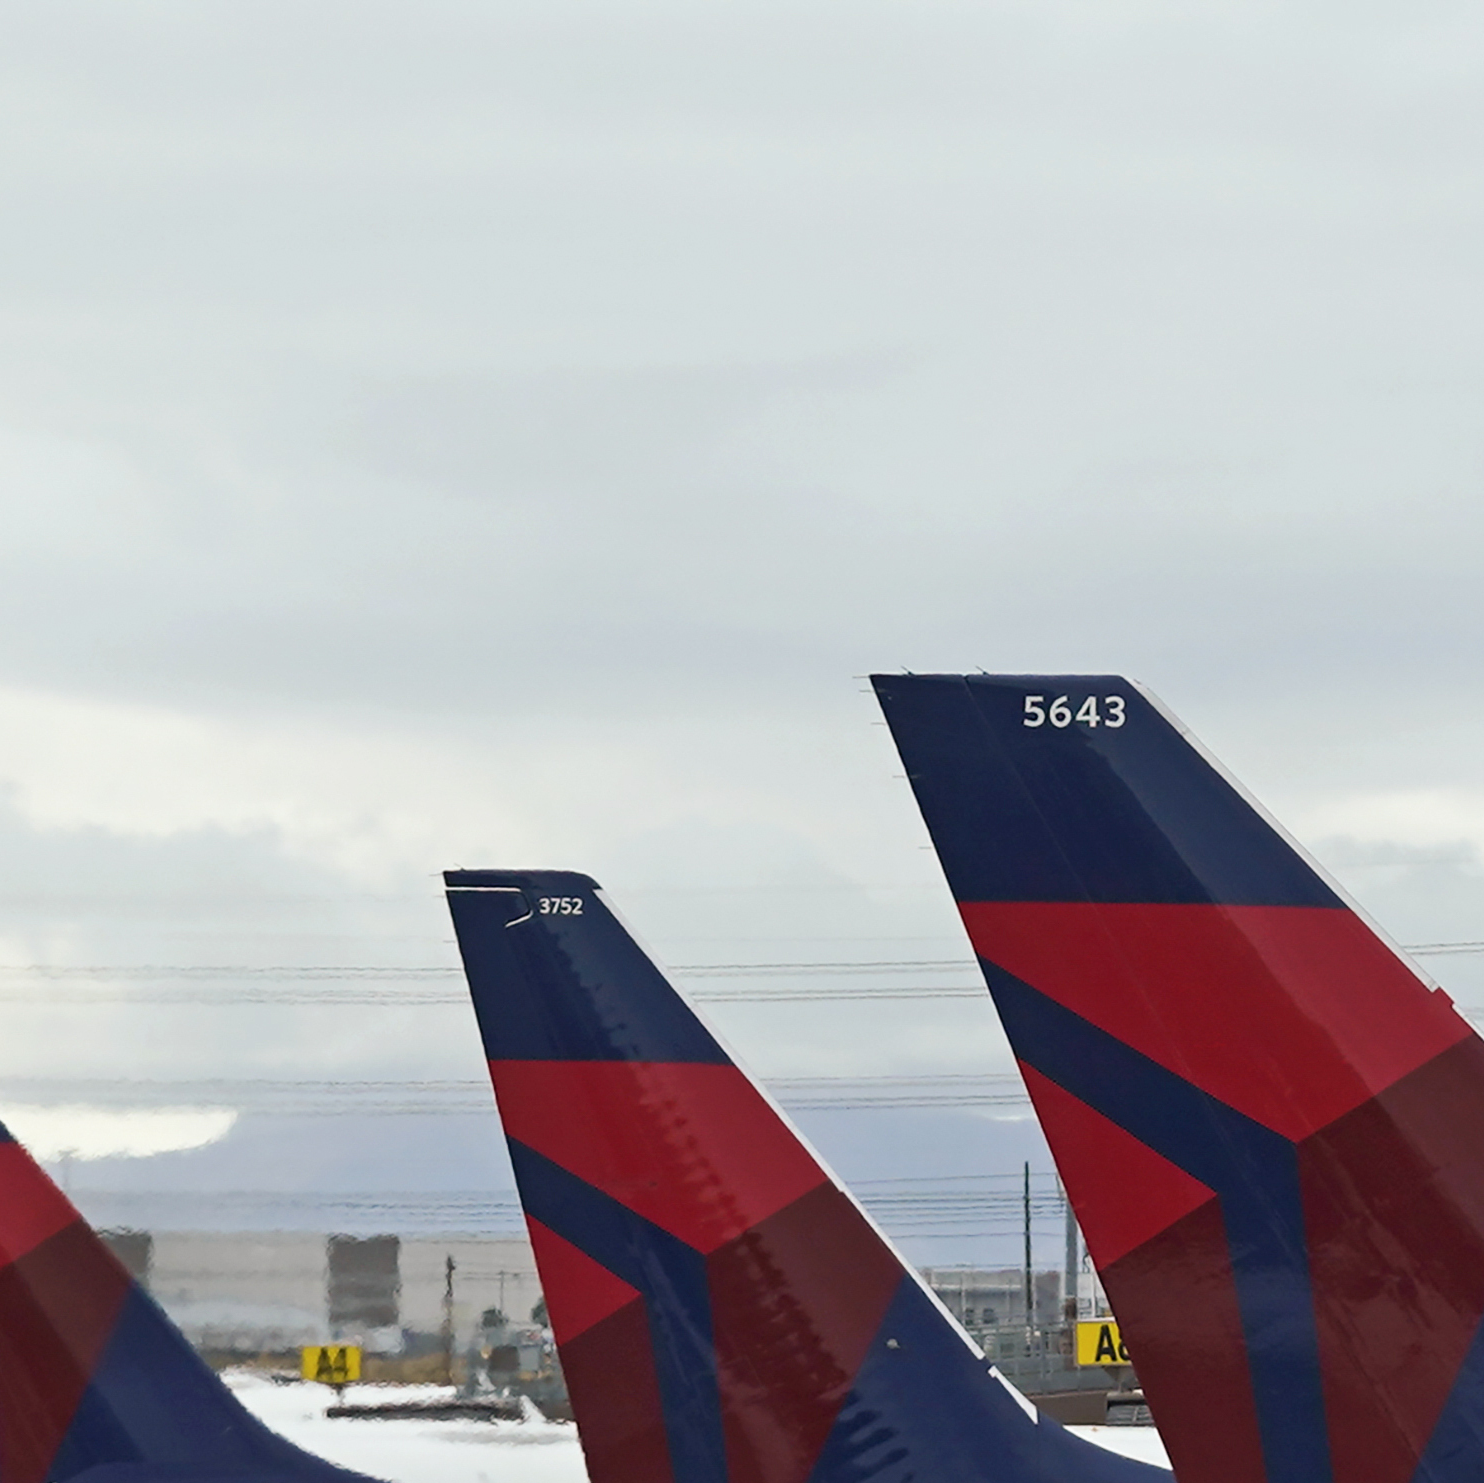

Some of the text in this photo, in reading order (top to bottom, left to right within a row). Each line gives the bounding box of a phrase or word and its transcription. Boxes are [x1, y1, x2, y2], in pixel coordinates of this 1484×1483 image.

[1023, 695, 1126, 728] 5643
[539, 897, 584, 915] 3752
[316, 1347, 349, 1378] A4
